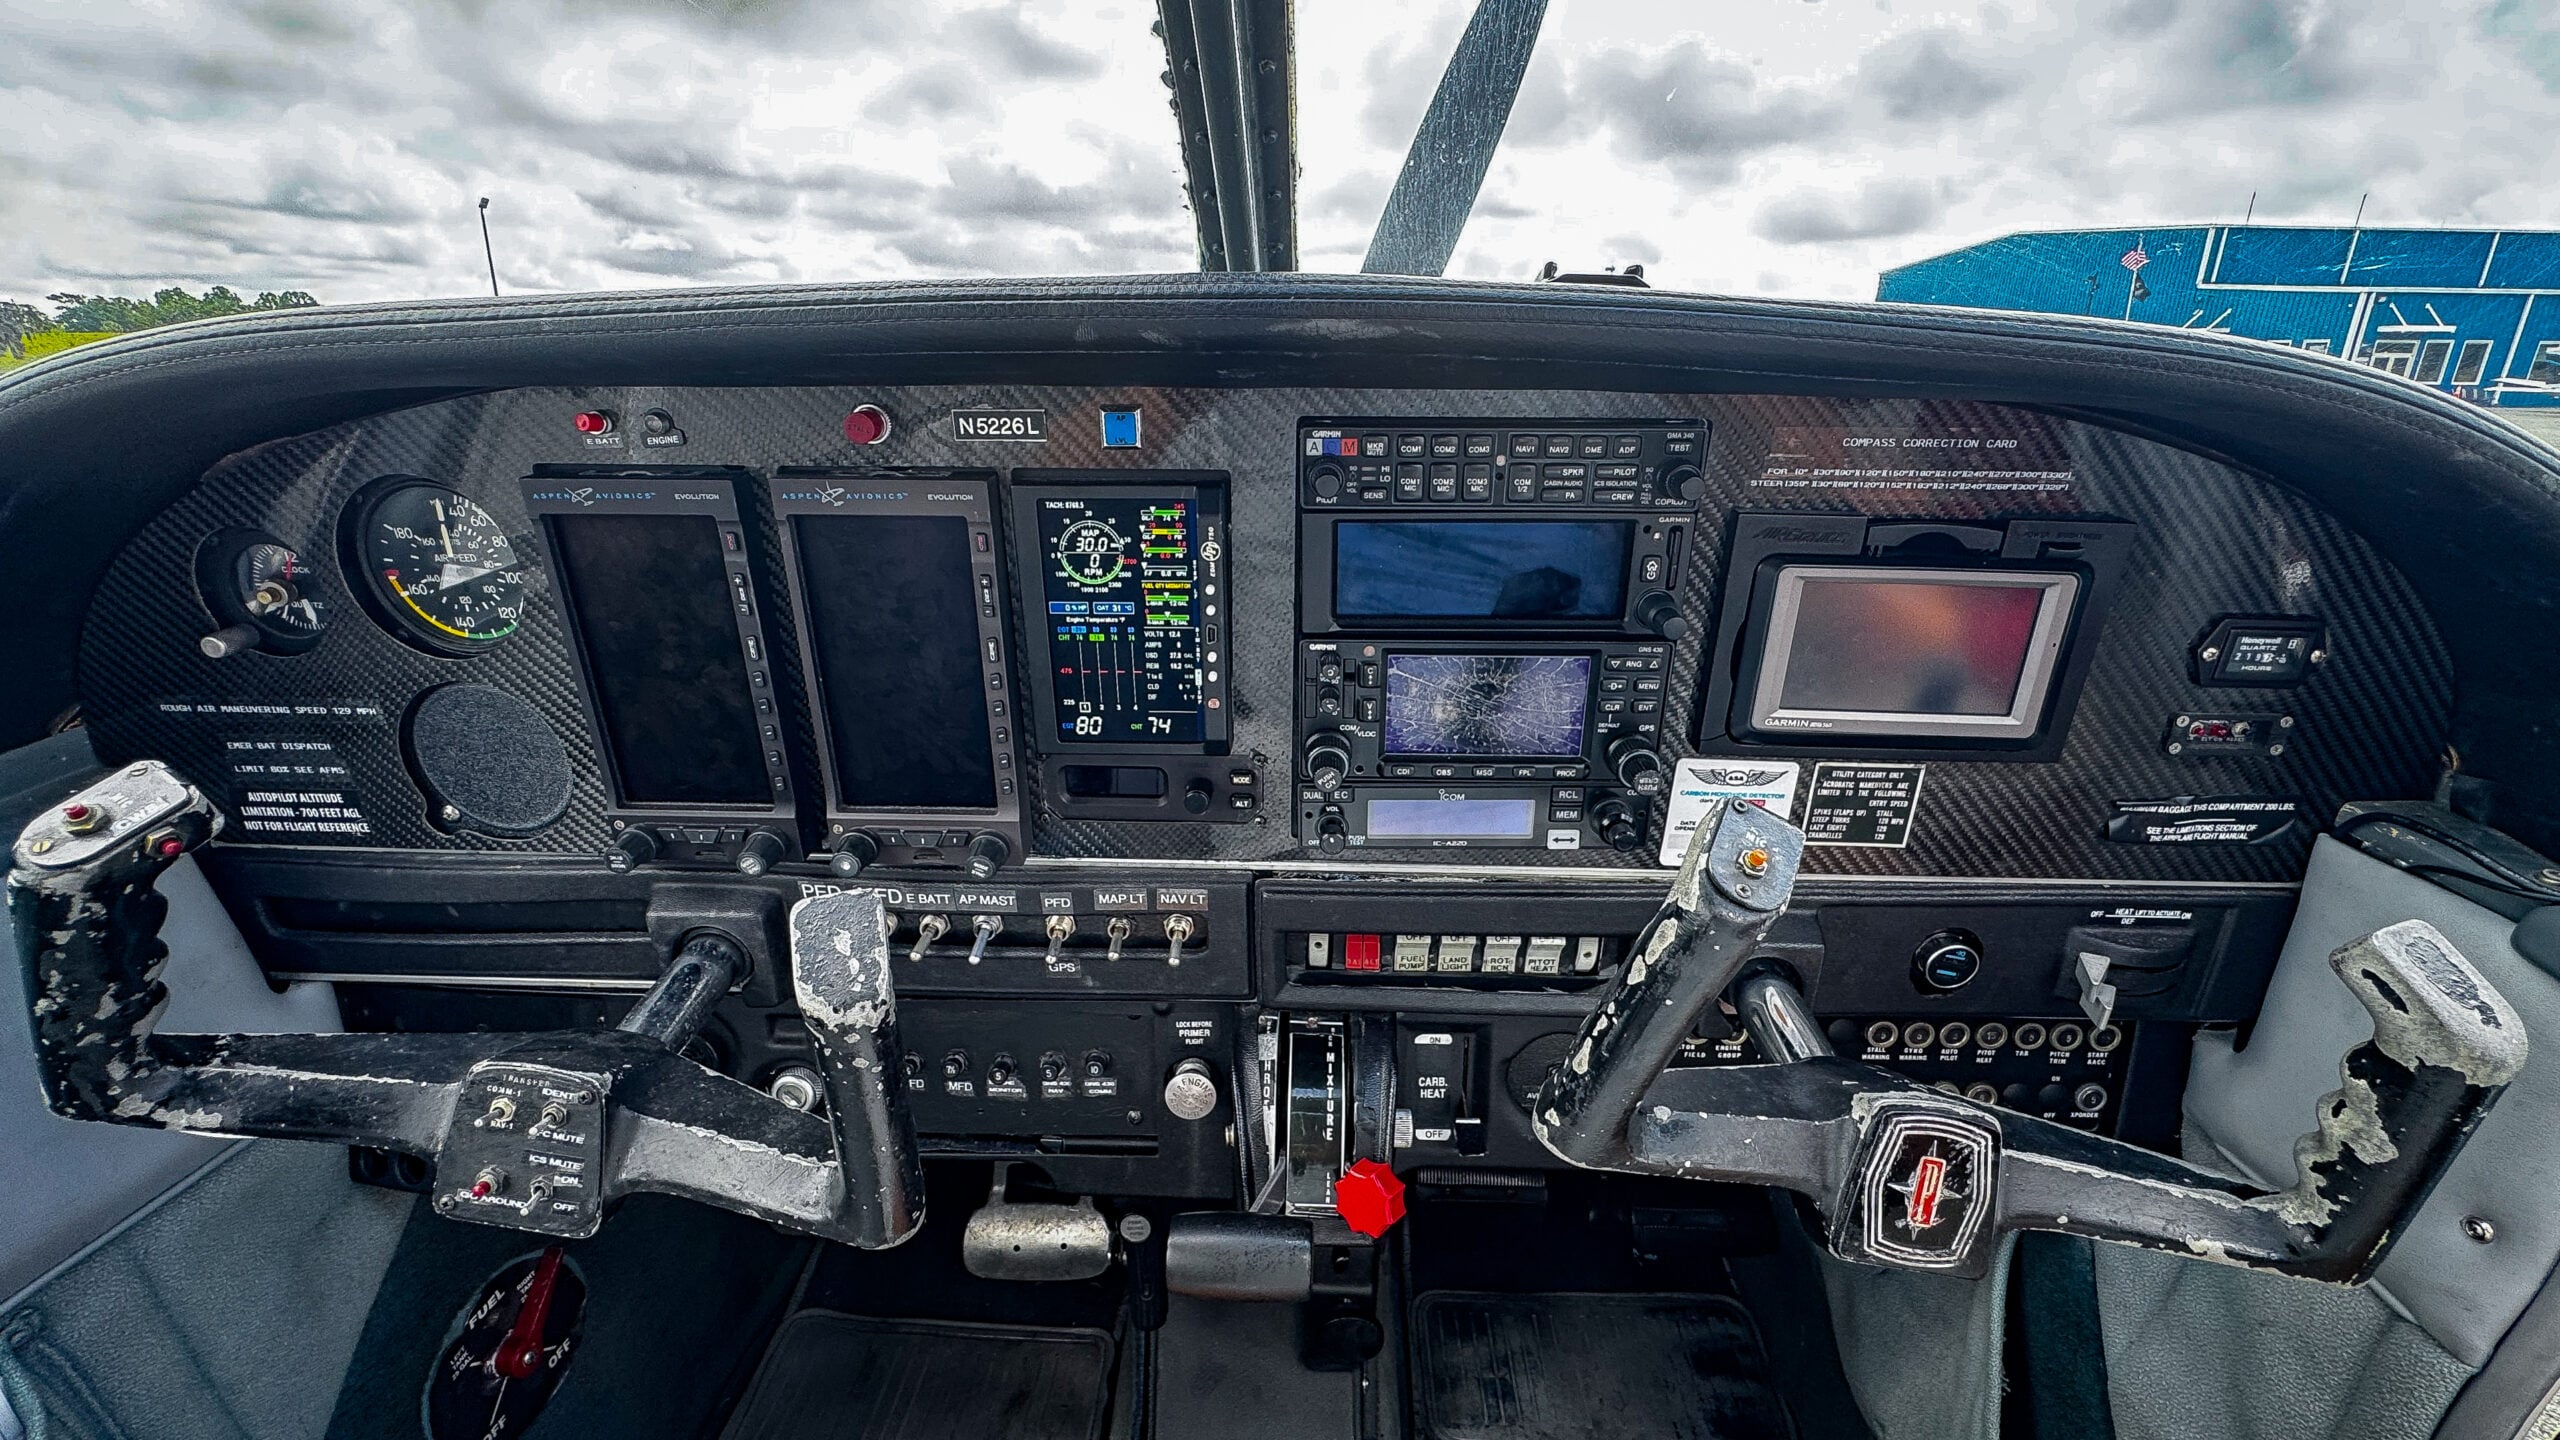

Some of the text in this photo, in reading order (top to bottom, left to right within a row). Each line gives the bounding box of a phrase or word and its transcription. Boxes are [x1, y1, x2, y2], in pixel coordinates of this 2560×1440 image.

[959, 417, 1040, 436] N5226L
[595, 436, 619, 445] BATT
[646, 436, 680, 445] ENGINE
[1842, 438, 2017, 449] COMPASS CORRECTION CARD
[1401, 445, 1422, 453] COM1
[1434, 445, 1456, 453] COM2
[1468, 446, 1490, 454] COM3
[1515, 445, 1535, 453] NAV1
[1585, 446, 1602, 454] DME
[1619, 446, 1635, 454] ADF
[1562, 468, 1583, 476] SPKR
[1613, 468, 1636, 476] PILOT
[533, 493, 570, 501] ASPEN
[674, 493, 720, 501] EVOLUTION
[781, 493, 819, 501] ASPEN
[1611, 493, 1634, 501] CREW
[449, 505, 465, 517] 40
[471, 515, 486, 527] 60
[393, 527, 412, 539] 180
[492, 536, 507, 548] 80
[1076, 538, 1108, 552] 30.0
[1089, 554, 1100, 568] 0
[408, 584, 427, 595] 160
[499, 607, 516, 619] 120
[454, 616, 475, 628] 140
[2241, 637, 2282, 645] Honeywell
[1638, 682, 1659, 690] MENU
[160, 704, 376, 715] ROUGH AIR MANEUVERING SPEED 129 MPH
[1076, 716, 1102, 735] 80
[1148, 717, 1171, 734] 74
[1764, 718, 1809, 728] GARMIN
[1556, 769, 1576, 777] PROC
[248, 792, 344, 803] AUTOPILOT ALTITUDE
[1303, 792, 1324, 800] DUAL
[1559, 791, 1578, 799] RCL
[2208, 803, 2264, 811] COMPARTMENT
[320, 808, 362, 817] FEET AGL
[1556, 810, 1578, 819] MEM
[244, 821, 371, 833] NOT FOR FLIGHT REFERENCE
[2146, 824, 2245, 834] SEE SECTION
[2194, 832, 2248, 840] FLIGHT MANUAL
[918, 893, 951, 905] BATT
[959, 895, 1016, 906] AP MAST
[1044, 897, 1071, 909] PFD
[1099, 893, 1145, 904] MAP LT
[1160, 894, 1184, 905] NAV
[2115, 908, 2134, 916] HEAT
[1400, 956, 1424, 964] FUEL
[1443, 957, 1468, 965] LAND
[1528, 958, 1556, 966] PITOT
[1048, 963, 1075, 973] GPS
[1441, 963, 1470, 971] LIGHT
[1178, 1029, 1210, 1037] PRIMER
[948, 1082, 972, 1092] MFD
[1418, 1077, 1448, 1088] CARB.
[542, 1088, 575, 1100] IDENT
[1326, 1052, 1335, 1141] MIXTURE
[1420, 1088, 1446, 1099] HEAT
[553, 1133, 585, 1144] MUTE
[1425, 1130, 1444, 1139] OFF
[529, 1154, 583, 1170] ICS MUTE
[553, 1203, 576, 1211] OFF
[516, 1271, 536, 1290] RIGHT
[469, 1289, 505, 1330] FUEL
[548, 1338, 571, 1368] OFF
